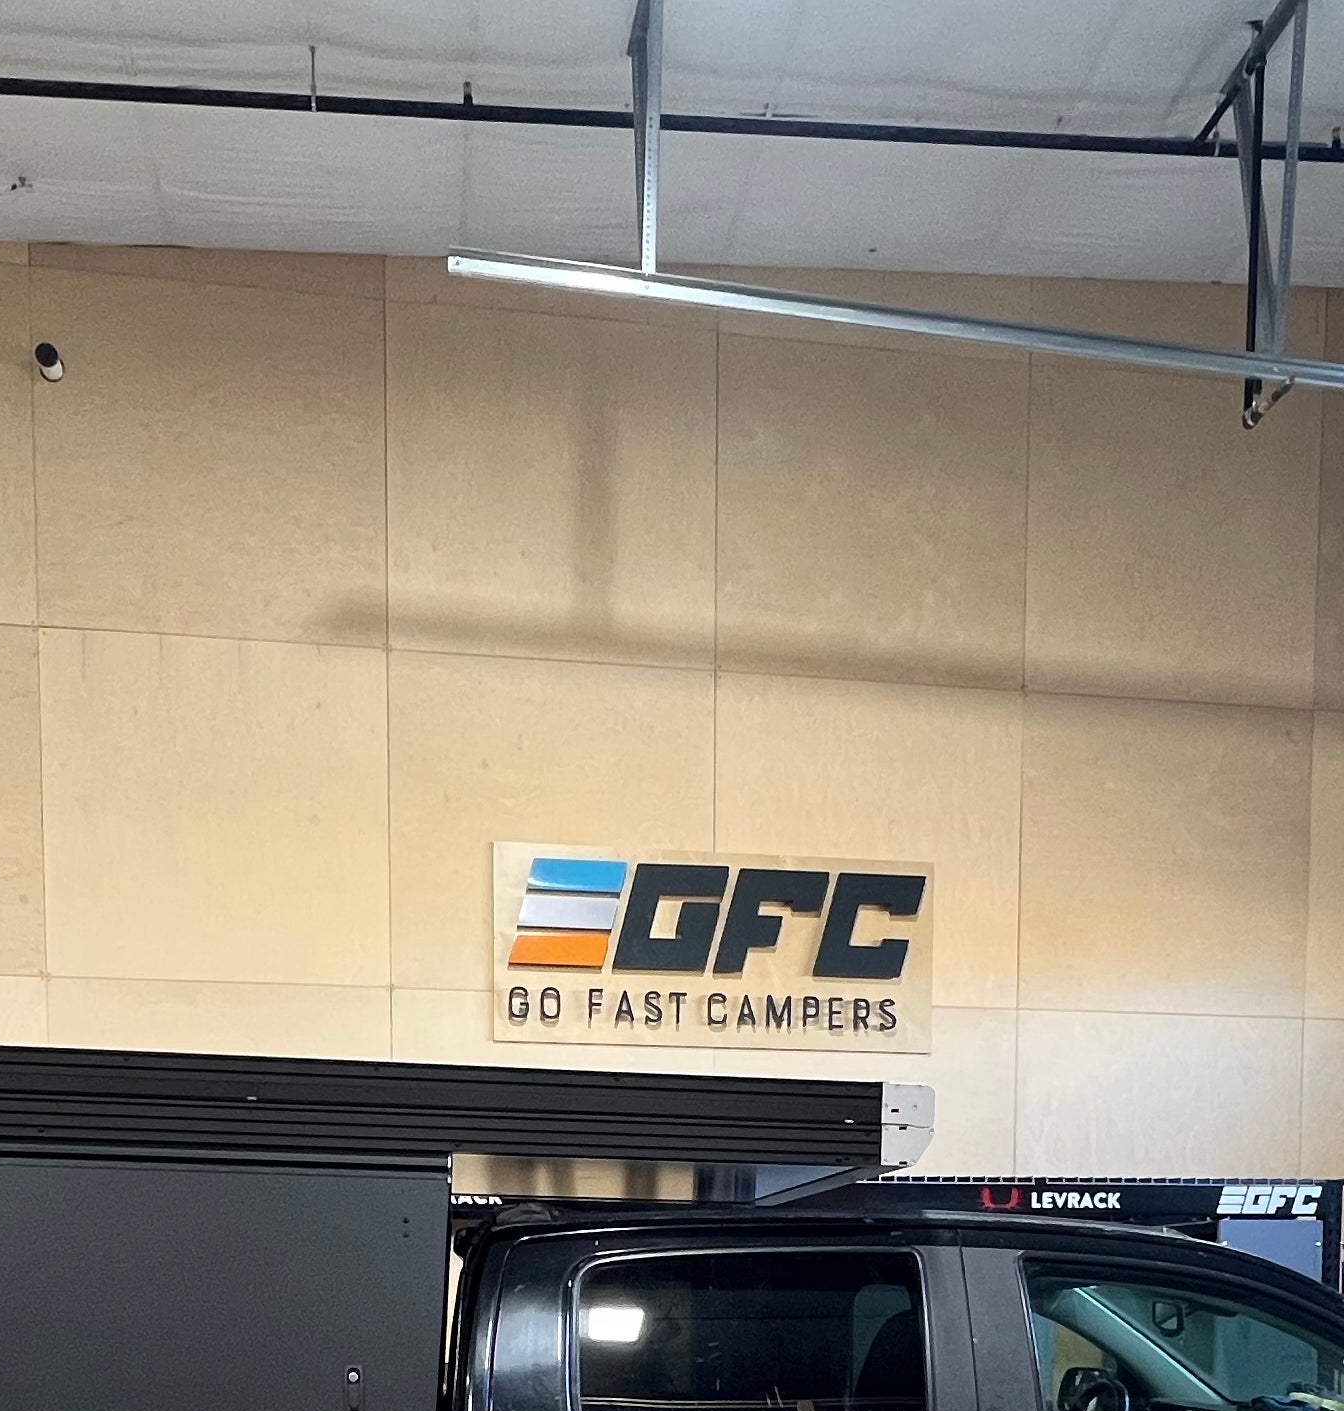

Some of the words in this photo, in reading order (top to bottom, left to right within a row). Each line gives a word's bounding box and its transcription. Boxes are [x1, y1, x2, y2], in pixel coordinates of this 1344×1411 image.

[508, 986, 561, 1021] GO
[588, 988, 687, 1025] FAST
[706, 993, 898, 1032] CAMPERS
[1031, 1192, 1121, 1209] LEVRACK
